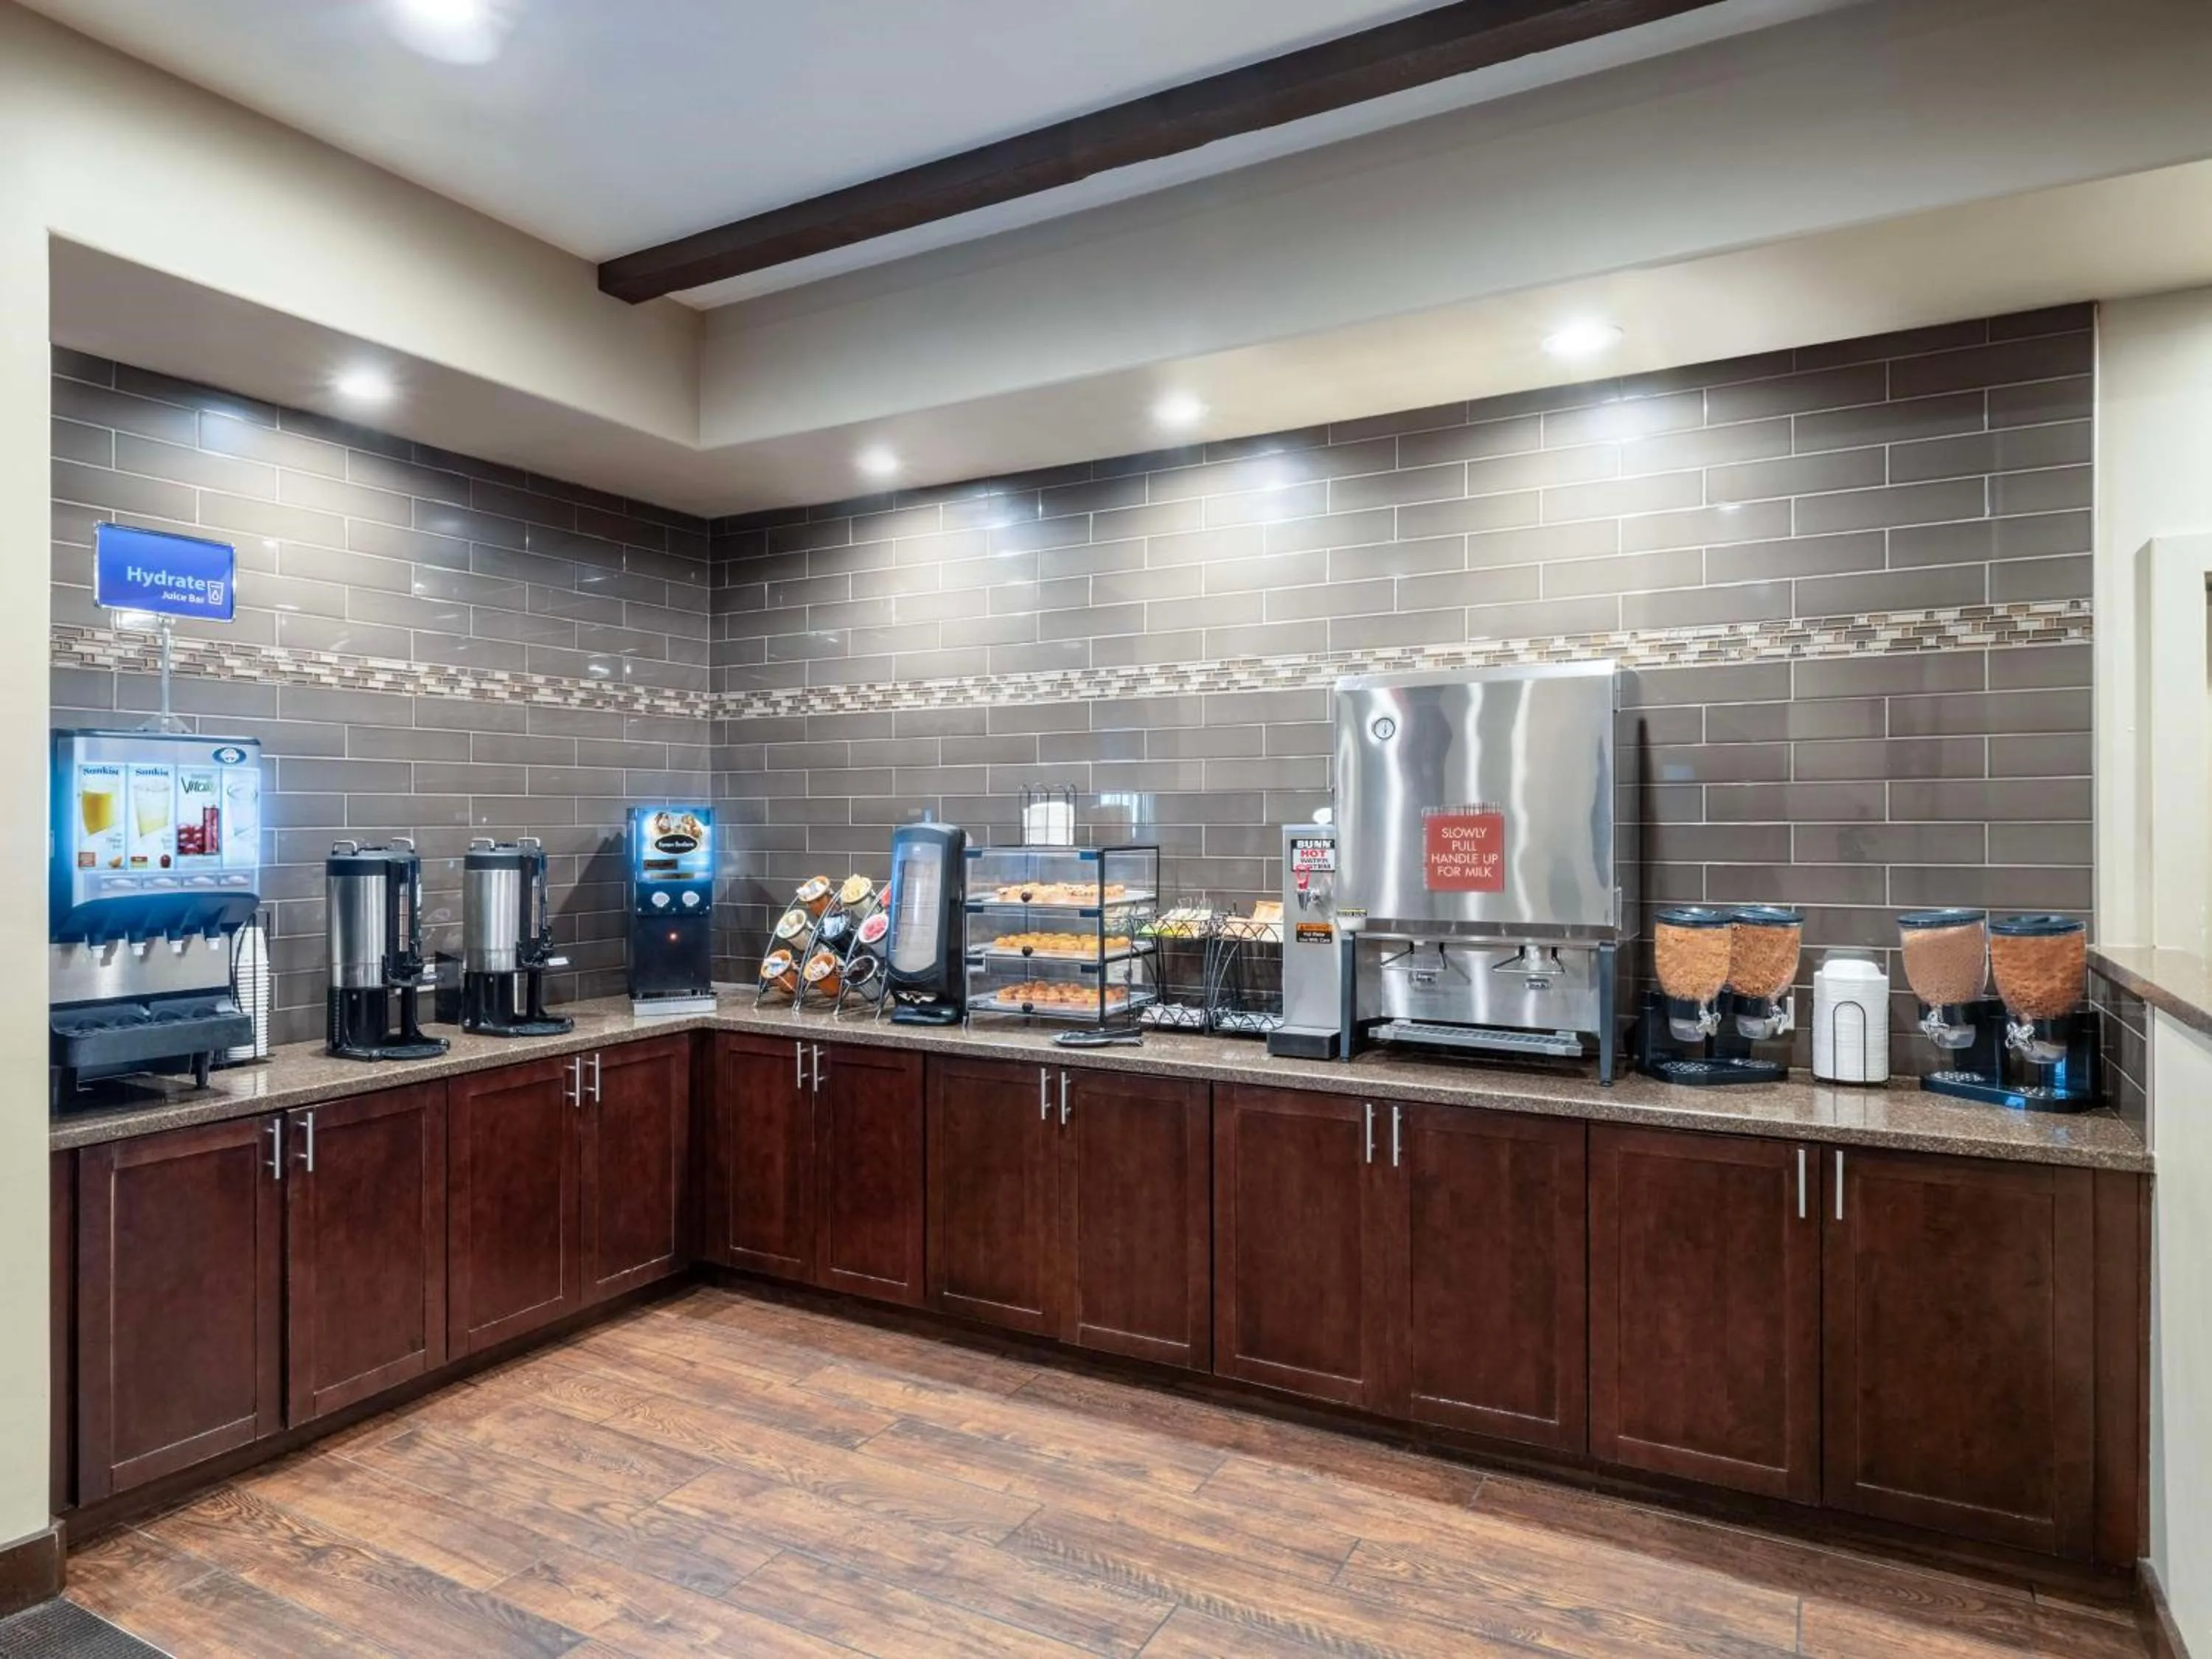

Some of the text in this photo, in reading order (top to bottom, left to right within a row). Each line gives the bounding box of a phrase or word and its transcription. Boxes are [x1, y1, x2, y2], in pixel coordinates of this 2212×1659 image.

[127, 566, 206, 591] Hydrate
[161, 591, 205, 604] Juice Bar
[1441, 827, 1487, 838] SLOWLY
[1297, 840, 1332, 848] BUNN
[1452, 841, 1477, 852] PULL
[1431, 853, 1499, 865] HANDLE UP
[1438, 866, 1493, 877] FOR MILK
